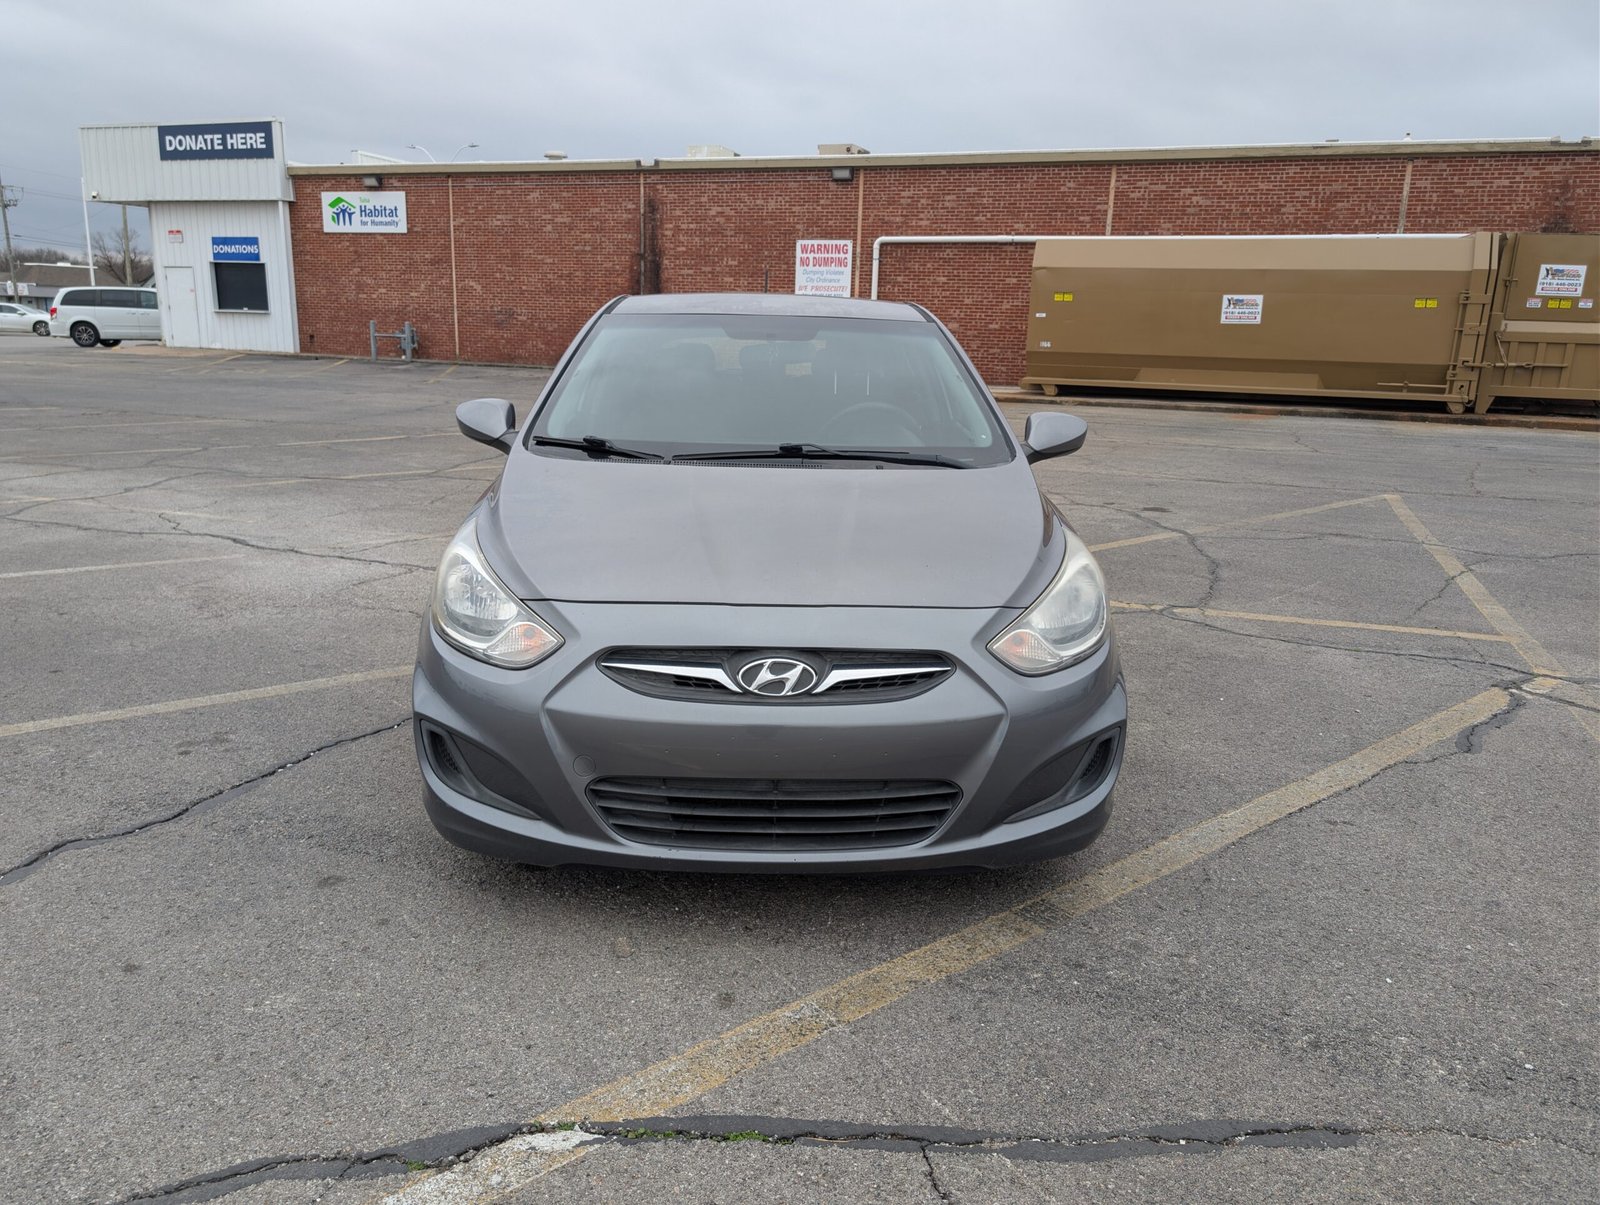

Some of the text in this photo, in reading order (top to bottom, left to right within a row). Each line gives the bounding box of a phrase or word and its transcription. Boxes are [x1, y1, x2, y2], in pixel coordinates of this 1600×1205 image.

[165, 133, 266, 151] DONATE HERE
[360, 205, 398, 218] Habitat
[360, 219, 399, 228] for Humanity
[213, 244, 259, 254] DONATIONS
[800, 243, 849, 255] WARNING
[800, 256, 848, 268] NO DUMPING
